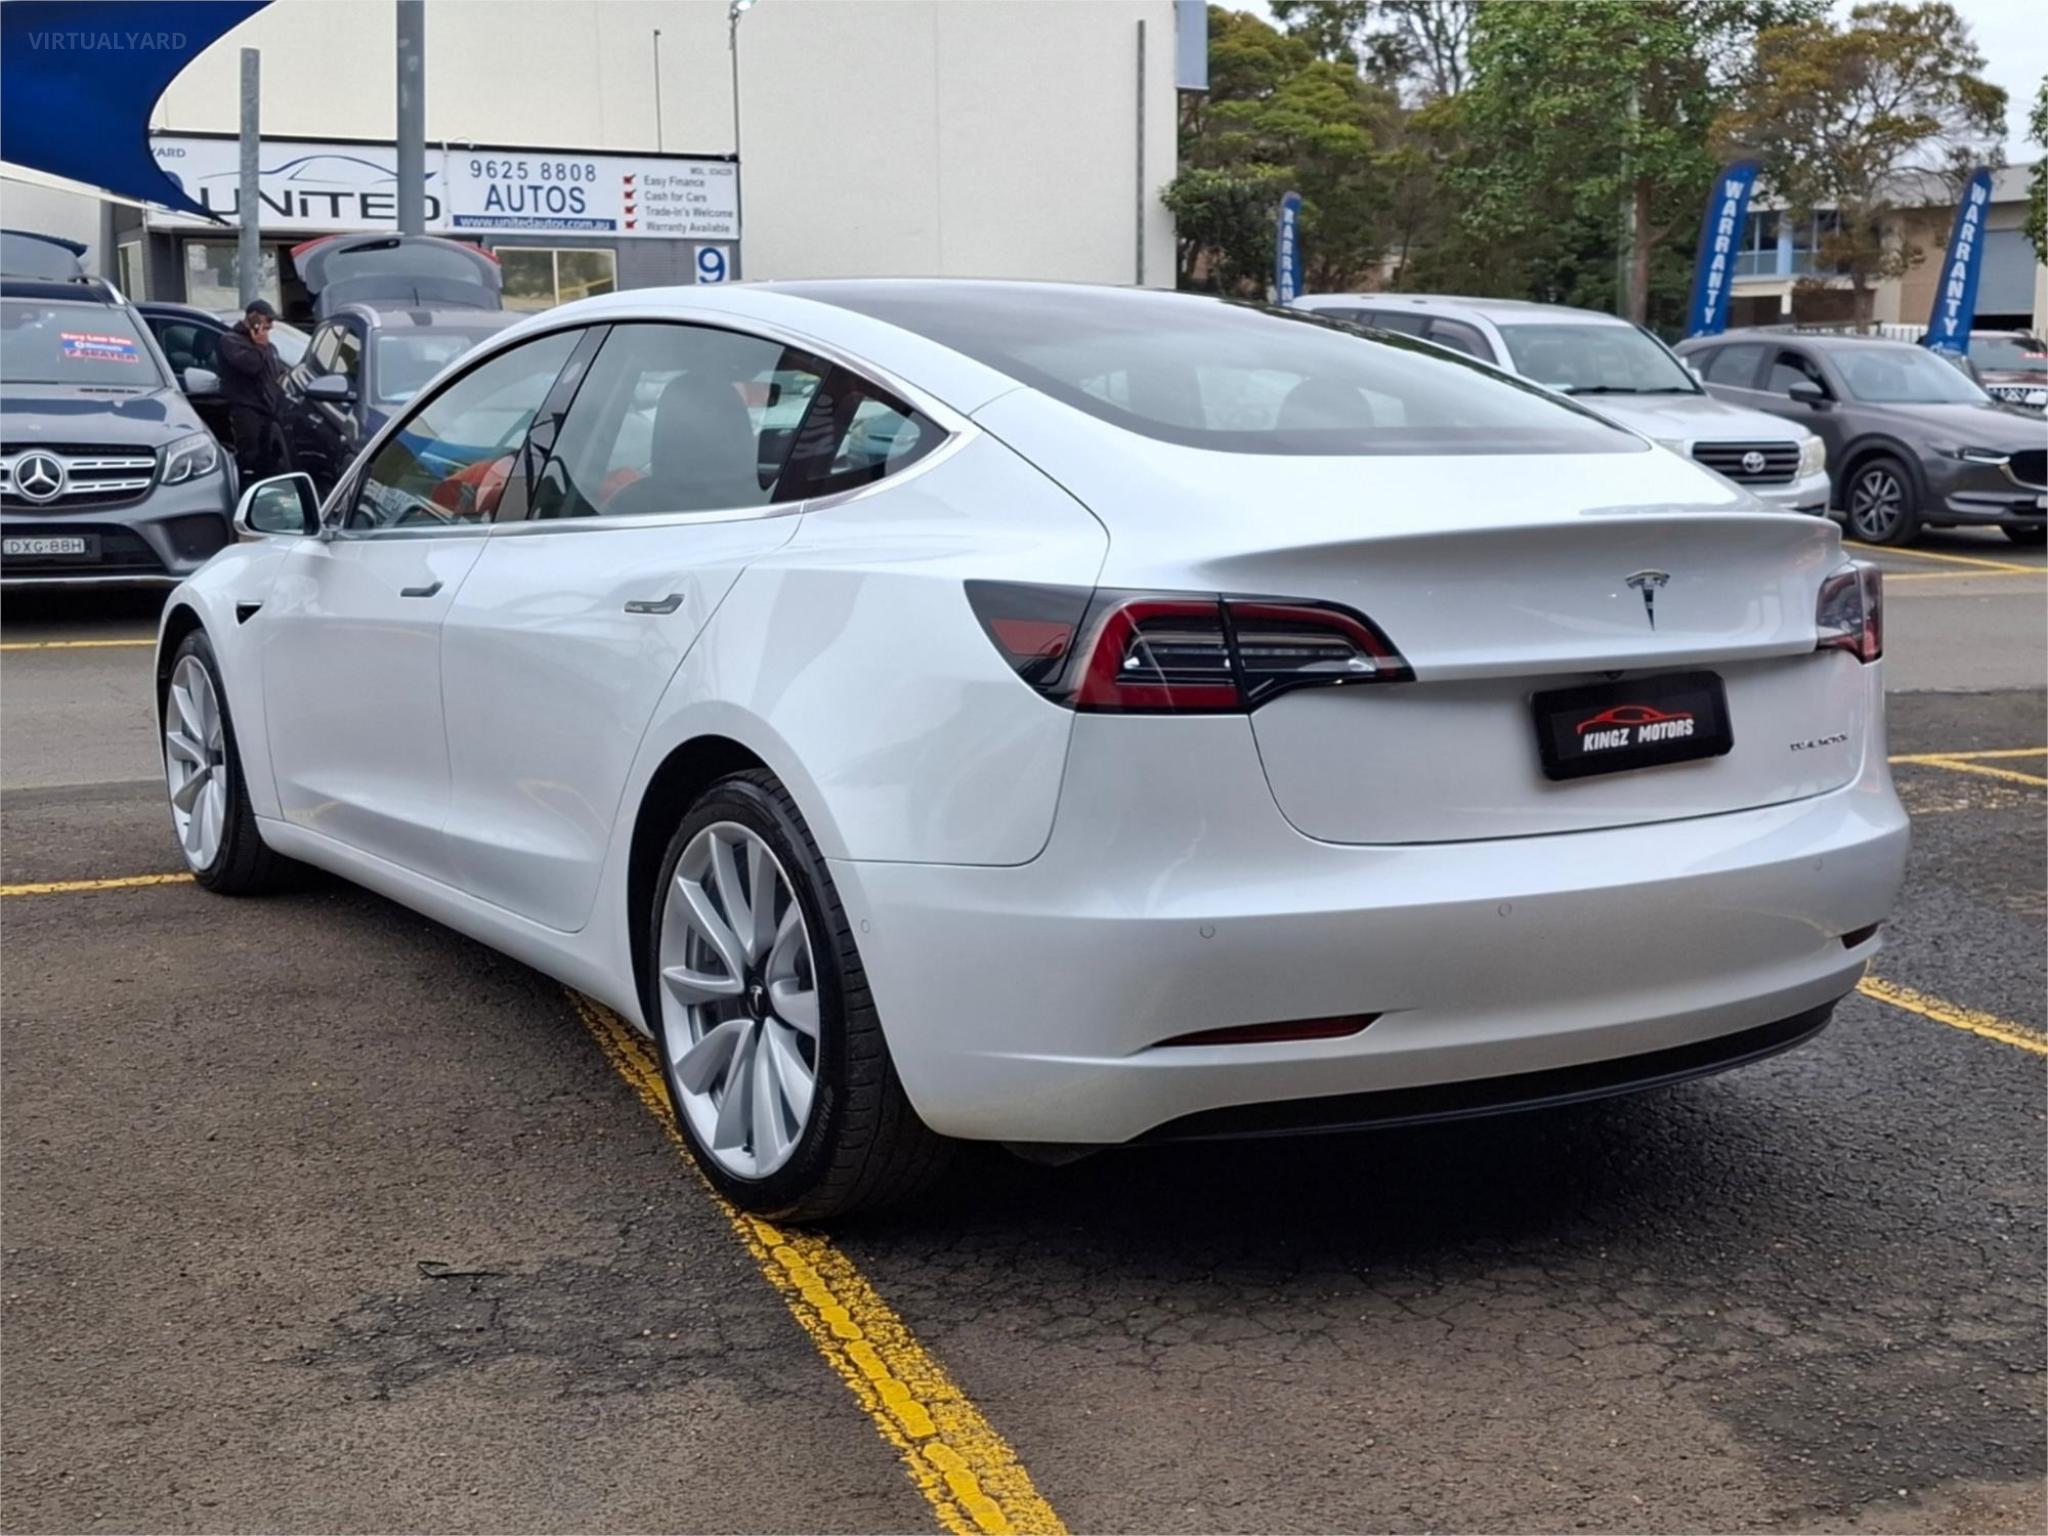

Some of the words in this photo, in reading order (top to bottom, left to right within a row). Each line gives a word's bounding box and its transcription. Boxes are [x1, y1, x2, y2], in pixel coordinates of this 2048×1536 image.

[470, 160, 528, 180] 9625
[540, 162, 596, 182] 8808
[644, 175, 667, 188] Easy
[669, 176, 705, 188] Finance
[484, 183, 586, 214] AUTOS
[644, 191, 668, 201] Cash
[670, 192, 683, 201] for
[686, 192, 707, 203] Cars
[460, 216, 610, 232] www.unitedautos.com.au
[693, 208, 733, 219] Welcome
[646, 221, 687, 234] Warranty
[690, 222, 730, 233] Available
[1704, 179, 1744, 324] WARRANTY
[1943, 182, 1986, 337] WARRANTY
[697, 247, 725, 283] 9
[1583, 727, 1630, 752] KINGZ
[1638, 718, 1694, 743] MOTORS
